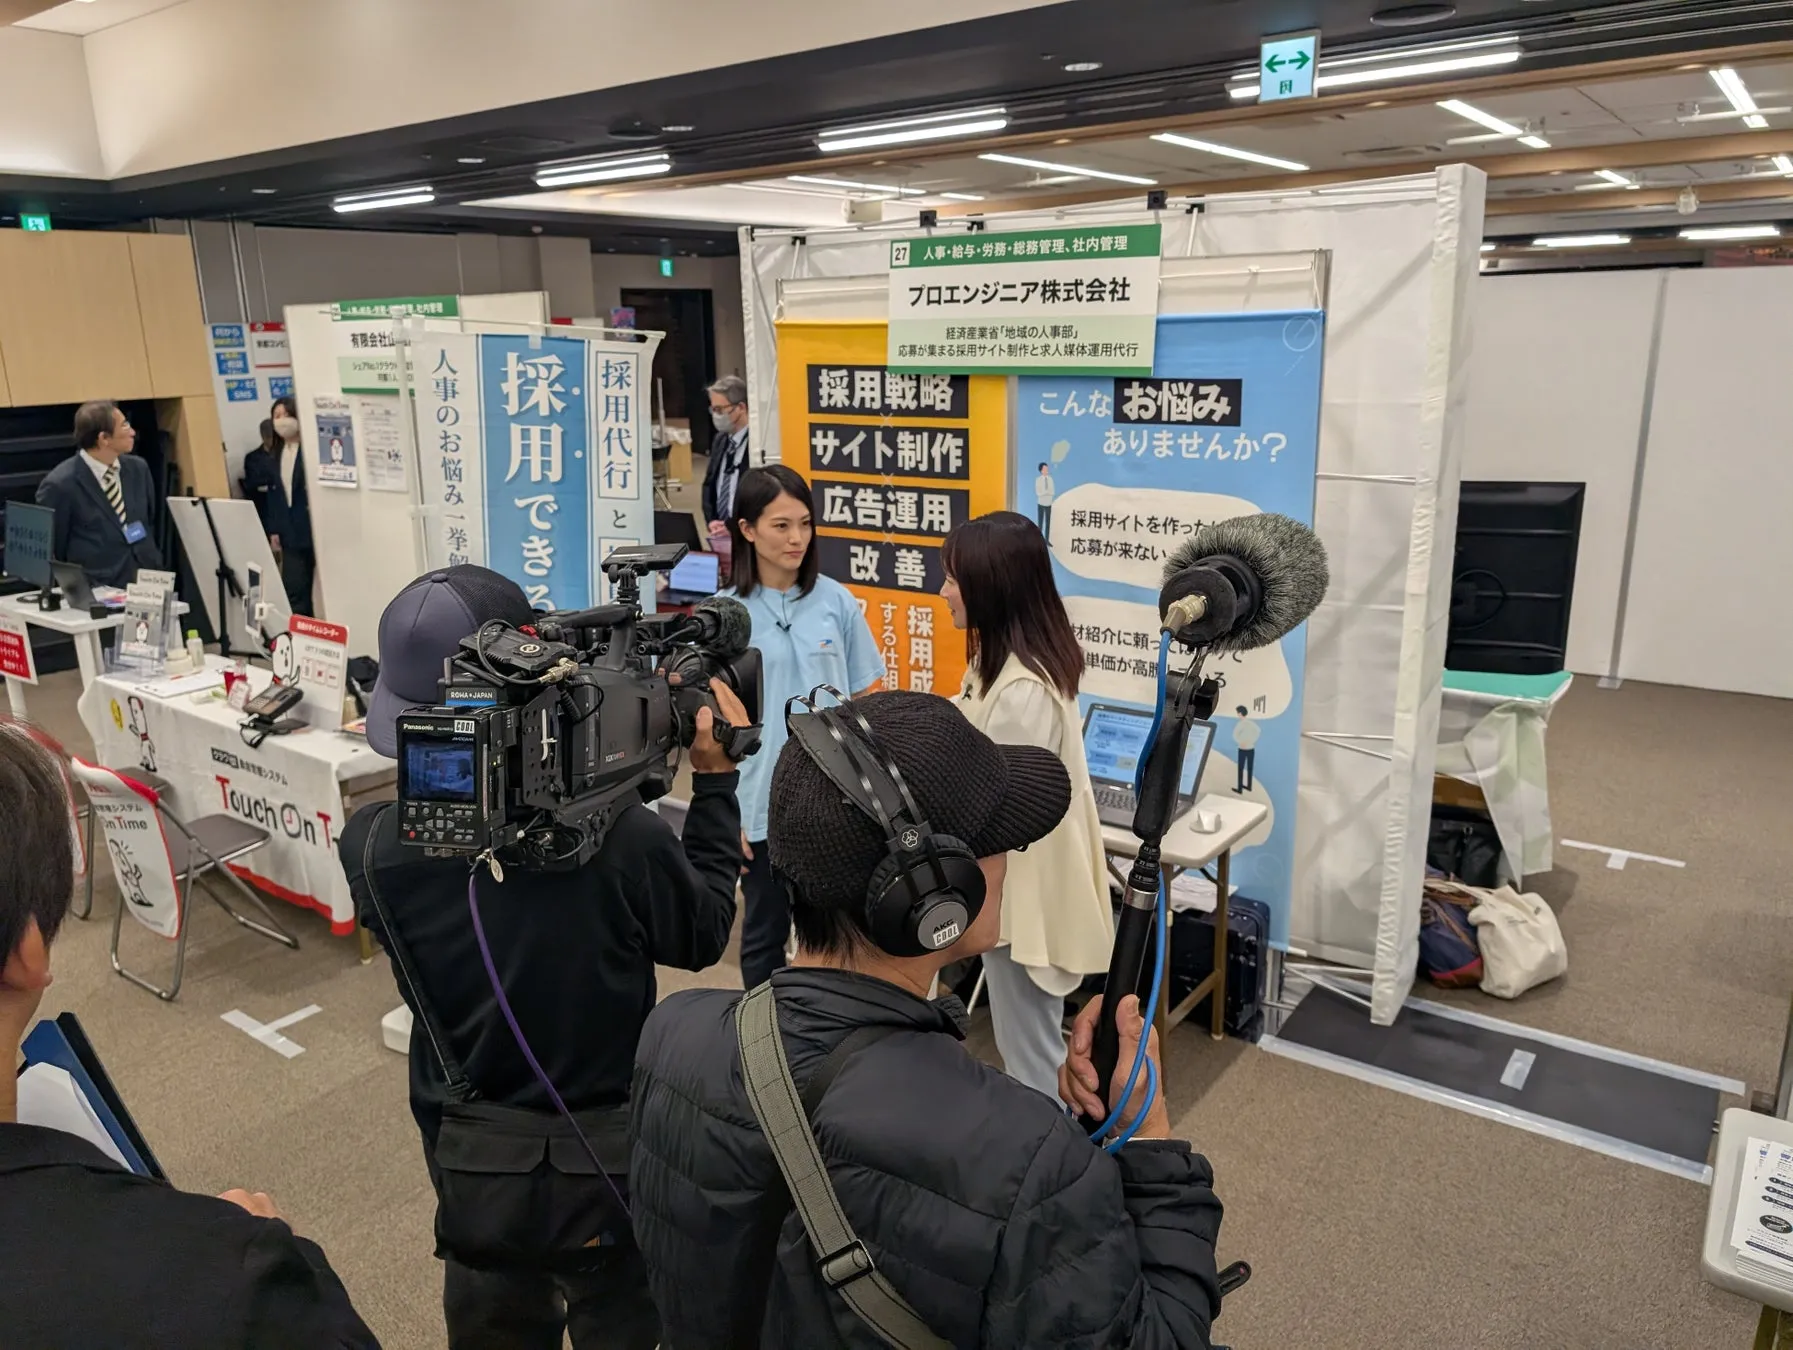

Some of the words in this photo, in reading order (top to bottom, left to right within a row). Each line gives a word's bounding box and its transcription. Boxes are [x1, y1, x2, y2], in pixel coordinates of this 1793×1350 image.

[894, 246, 909, 263] 27
[923, 235, 1128, 262] 人事・給与・労務・総務管理、社内管理
[908, 276, 1131, 307] プロエンジニア株式会社
[945, 324, 1079, 340] 経済産業省「地域の人事部」
[898, 343, 1139, 358] 応募が集まる採用サイト制作と求人媒体運用代行
[818, 370, 953, 411] 採用戦略
[601, 359, 633, 490] 採用代行
[811, 429, 964, 474] サイト制作
[612, 509, 628, 529] と
[822, 485, 952, 533] 広告運用
[1070, 537, 1167, 561] 応募が来ない
[849, 545, 927, 589] 改善
[403, 723, 435, 731] Panasonic
[114, 816, 148, 830] Time
[215, 774, 278, 830] Touch
[280, 802, 317, 845] On
[935, 924, 959, 946] COOL
